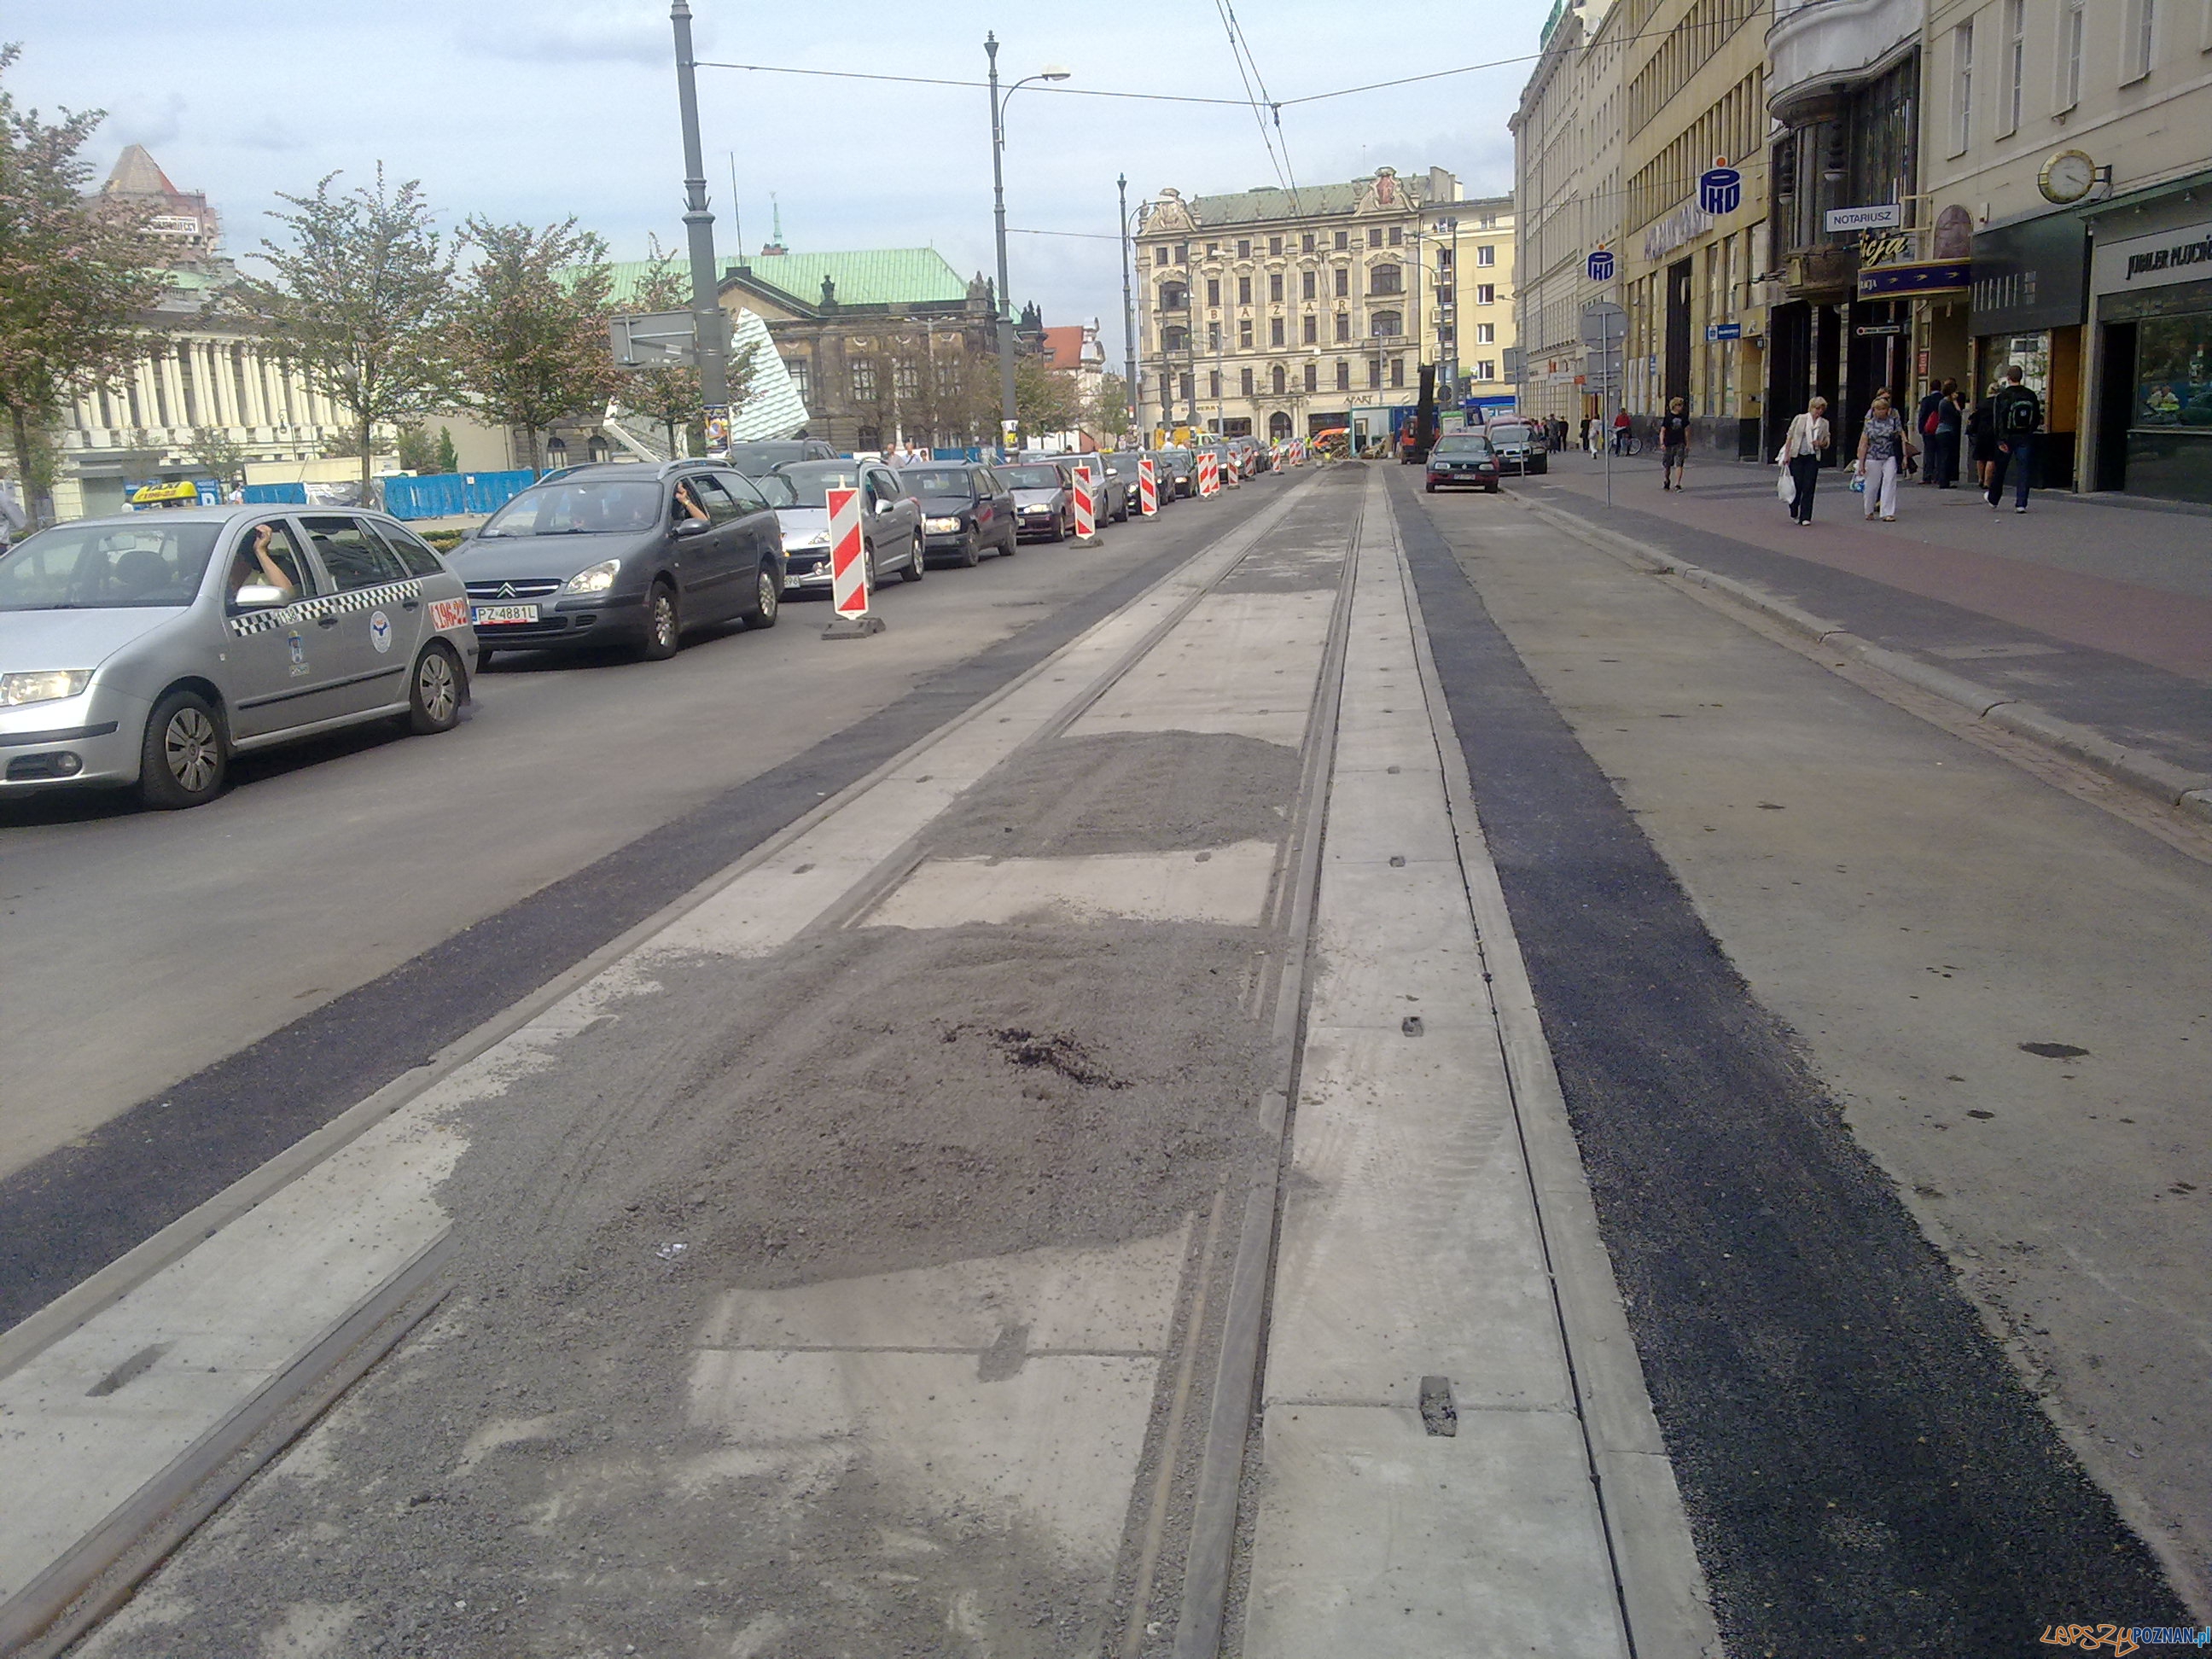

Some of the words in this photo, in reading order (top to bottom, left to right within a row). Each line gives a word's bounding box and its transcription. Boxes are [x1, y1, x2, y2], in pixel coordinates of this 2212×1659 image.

[1700, 168, 1740, 214] PKO
[1834, 212, 1892, 224] NOTARIUSZ
[1588, 251, 1614, 281] PKO
[1210, 300, 1346, 319] BAZAR
[1343, 395, 1372, 405] APART
[478, 608, 495, 620] PZ
[498, 607, 536, 619] 4881L
